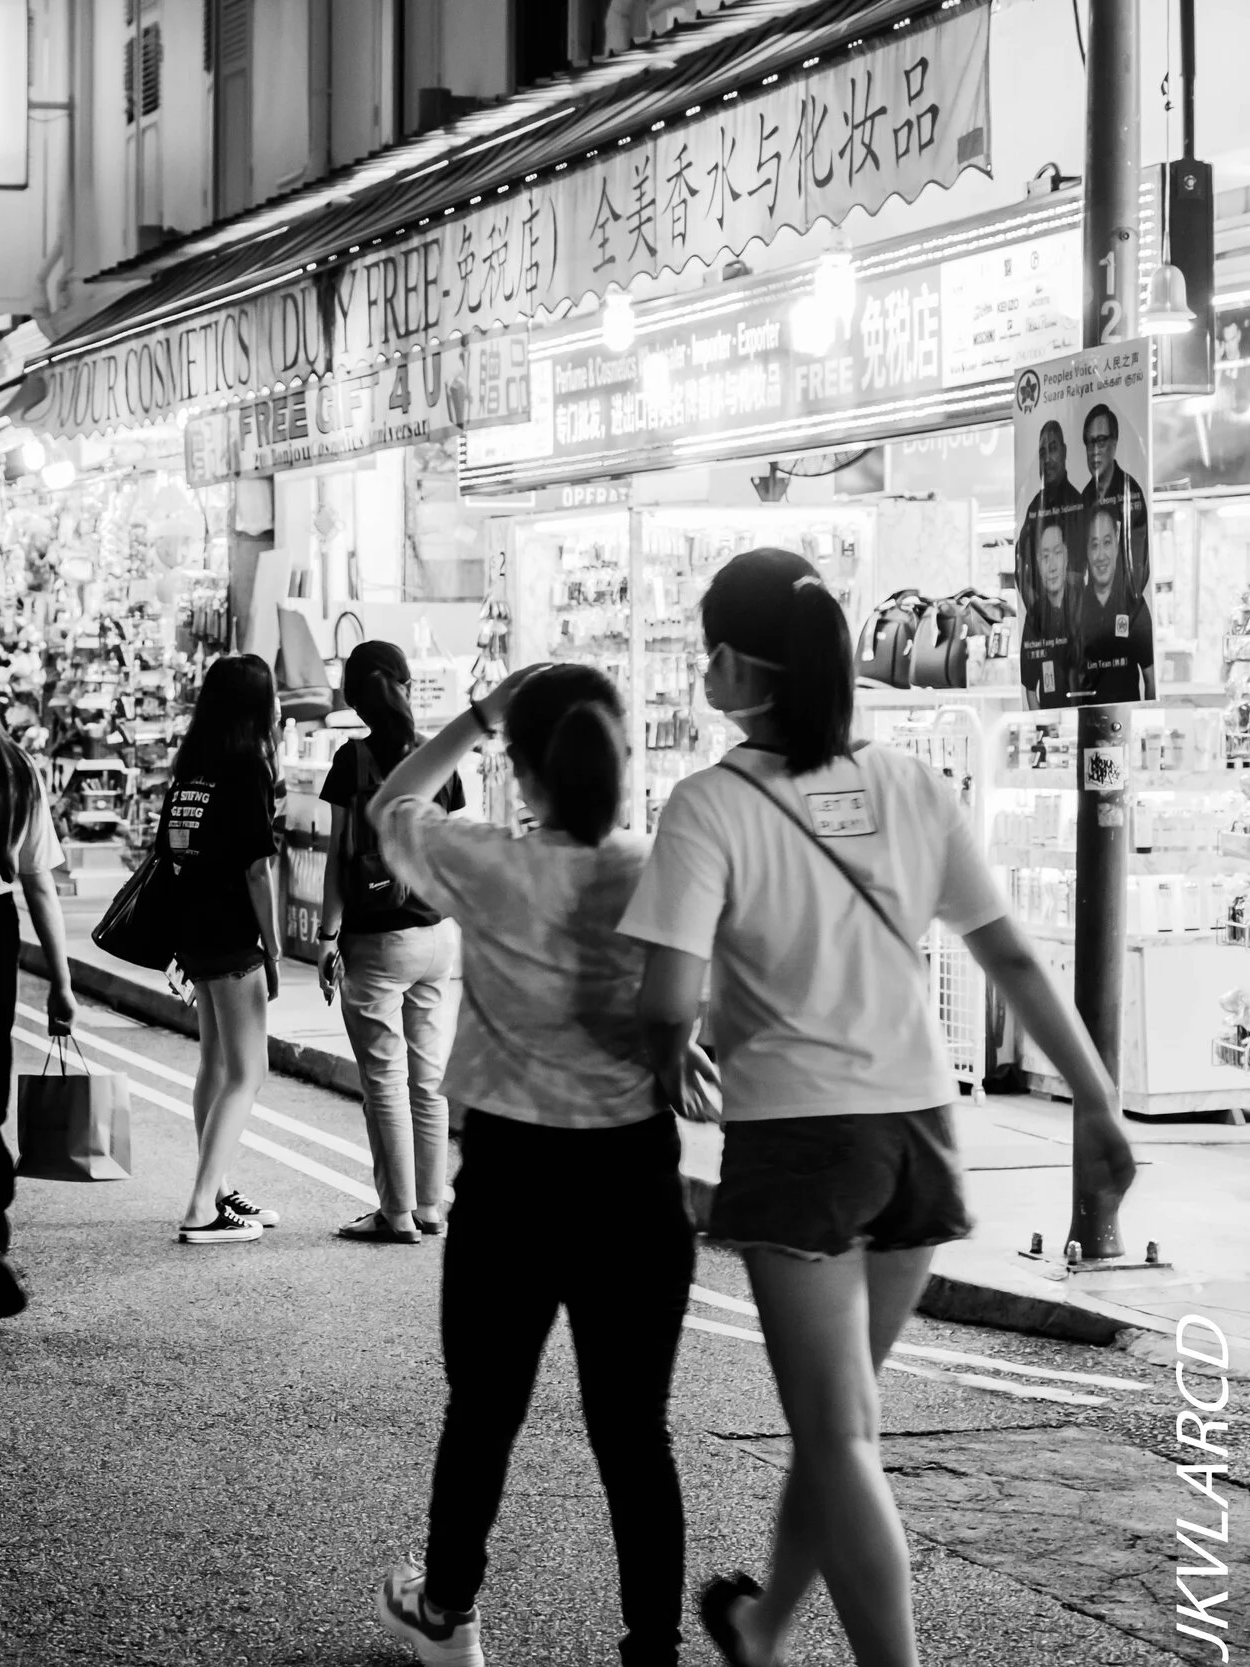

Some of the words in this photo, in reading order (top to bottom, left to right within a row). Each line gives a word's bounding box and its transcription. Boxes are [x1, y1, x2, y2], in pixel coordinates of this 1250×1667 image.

[125, 309, 251, 417] COSMETICS
[269, 268, 357, 380] (DUY
[589, 56, 941, 274] 全美香水与化妆品
[692, 329, 731, 371] Importer
[737, 318, 781, 361] Exporter
[861, 282, 939, 391] 免税店
[795, 357, 853, 402] FREE
[1043, 370, 1073, 387] Peoples
[1103, 352, 1140, 372] 人民之声
[239, 391, 309, 451] FREE
[389, 364, 412, 414] 4
[422, 351, 442, 408] U
[1043, 389, 1065, 404] Suara
[1066, 381, 1094, 398] Rakyat
